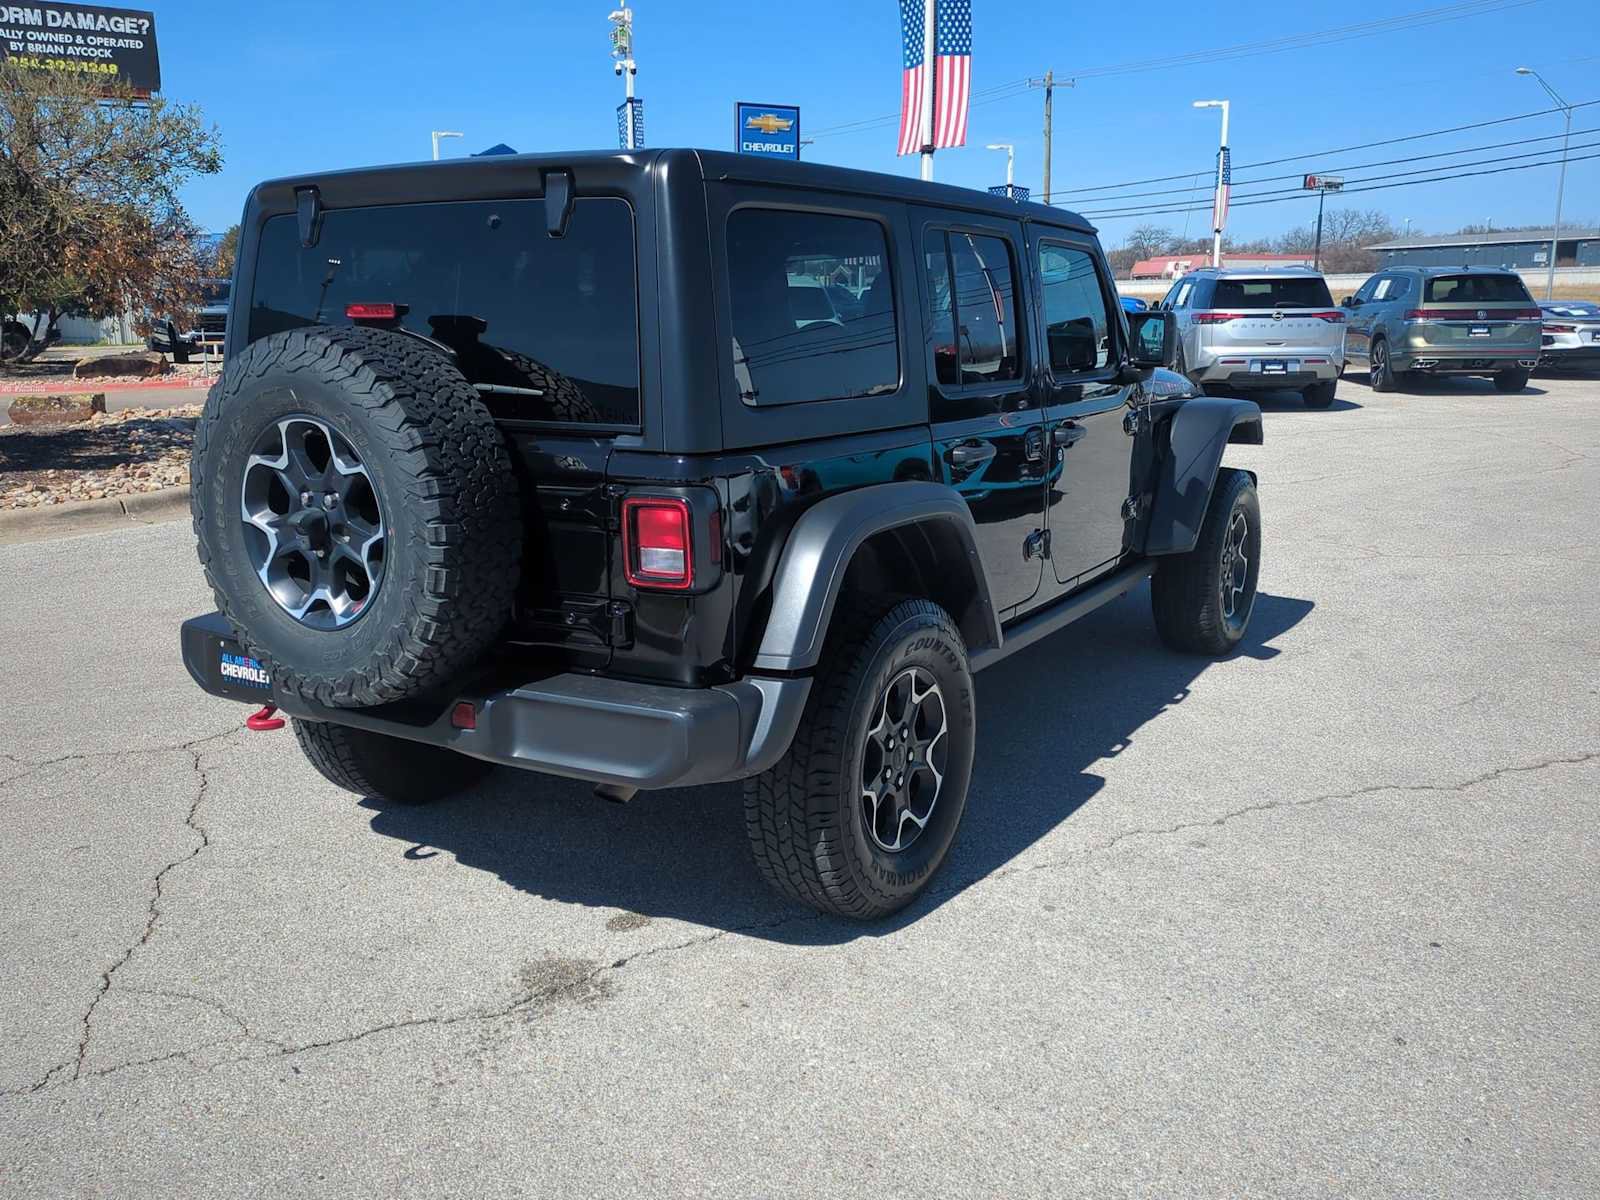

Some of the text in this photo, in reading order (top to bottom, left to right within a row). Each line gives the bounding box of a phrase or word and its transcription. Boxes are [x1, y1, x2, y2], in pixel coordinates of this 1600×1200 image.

[0, 6, 150, 35] ORM DAMAGE?
[0, 28, 144, 49] ALLY OWNED & OPERATED
[10, 41, 113, 58] BY BRIAN AYCOCK
[743, 142, 795, 153] CHEVROLET
